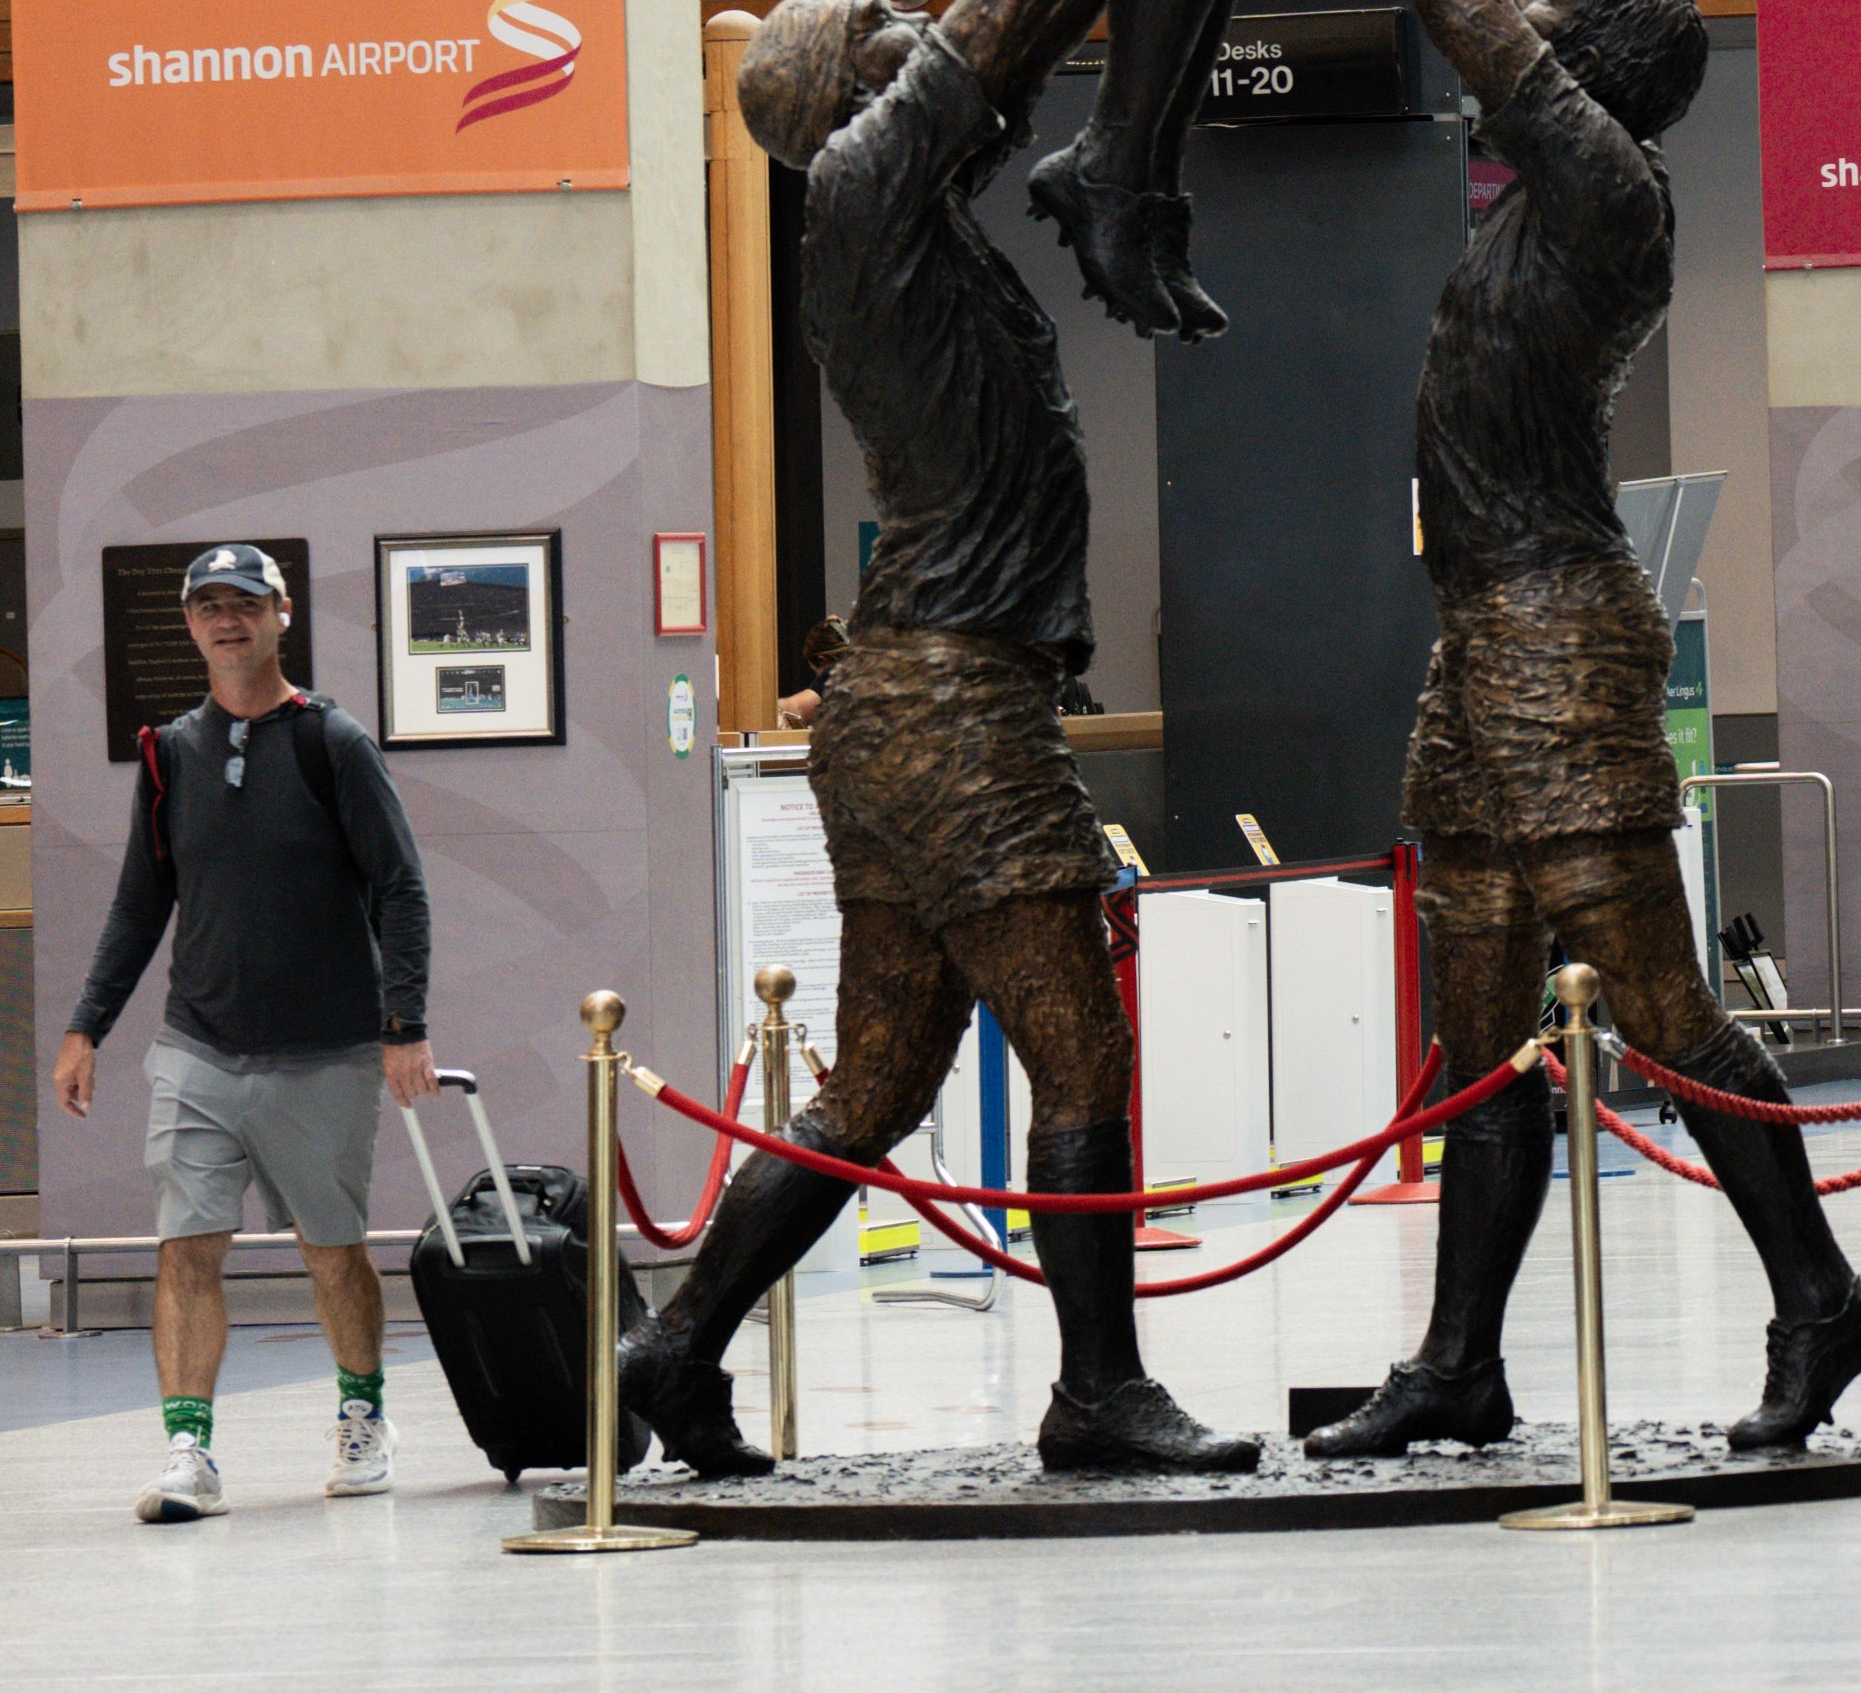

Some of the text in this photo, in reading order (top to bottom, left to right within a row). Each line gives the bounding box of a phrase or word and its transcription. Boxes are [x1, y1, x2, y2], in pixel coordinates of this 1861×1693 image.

[109, 39, 480, 87] shannon AIRPORT
[1217, 41, 1282, 61] Desks
[1211, 65, 1294, 97] 11-20
[1676, 685, 1695, 700] Lingus
